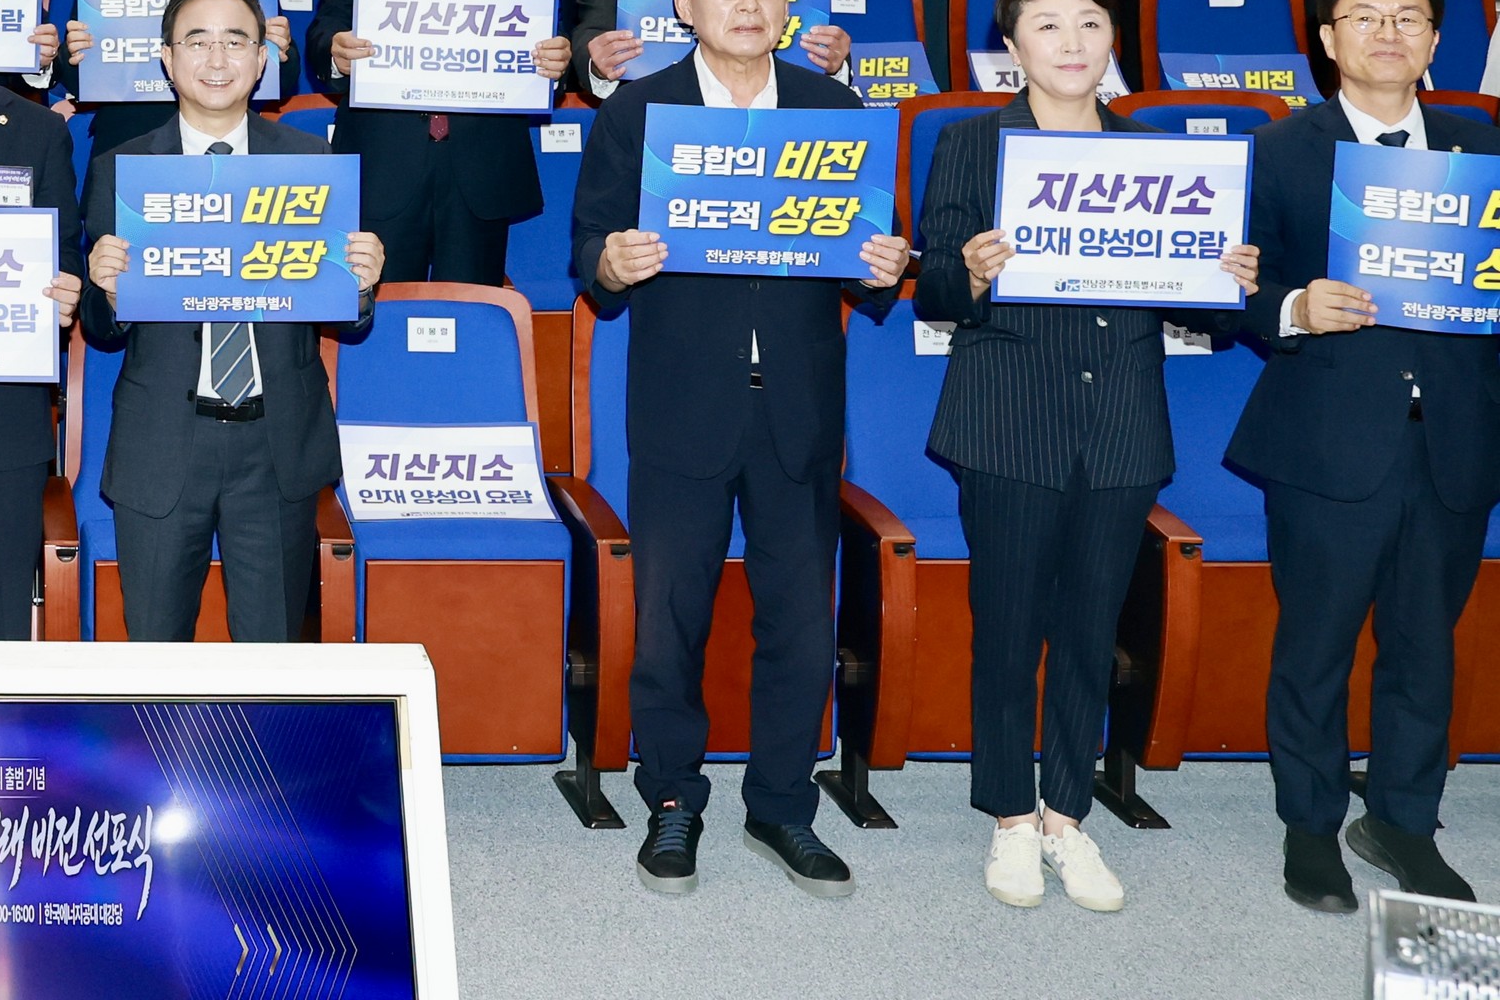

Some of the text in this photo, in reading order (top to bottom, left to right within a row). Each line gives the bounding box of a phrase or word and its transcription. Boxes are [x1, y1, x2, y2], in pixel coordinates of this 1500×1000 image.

[379, 2, 530, 37] 지산지소
[369, 45, 540, 75] 인재 양성의 요람
[1183, 71, 1294, 90] 통합의 비전
[672, 141, 867, 180] 통합의 비전
[143, 186, 329, 224] 통합의 비전
[1028, 173, 1215, 215] 지산지소
[1362, 185, 1470, 227] 통합의
[669, 196, 860, 235] 압도적 성장
[706, 249, 819, 266] 전남광주통합특별시
[1015, 226, 1227, 259] 인재 양성의 요람
[143, 241, 327, 279] 압도적 성장
[1358, 243, 1465, 285] 압도적
[1082, 278, 1185, 293] 전남광주통합특별시교육청
[183, 297, 291, 310] 전남광주통합특별시
[1401, 302, 1500, 323] 전남광주통합특
[364, 453, 514, 481] 지산지소
[358, 489, 533, 504] 인재 양성의 요람
[5, 766, 24, 790] 출범
[26, 766, 46, 790] 기념
[31, 806, 83, 877] 비전
[83, 805, 154, 921] 선포식
[44, 904, 123, 926] 한국에너지공대 대강당
